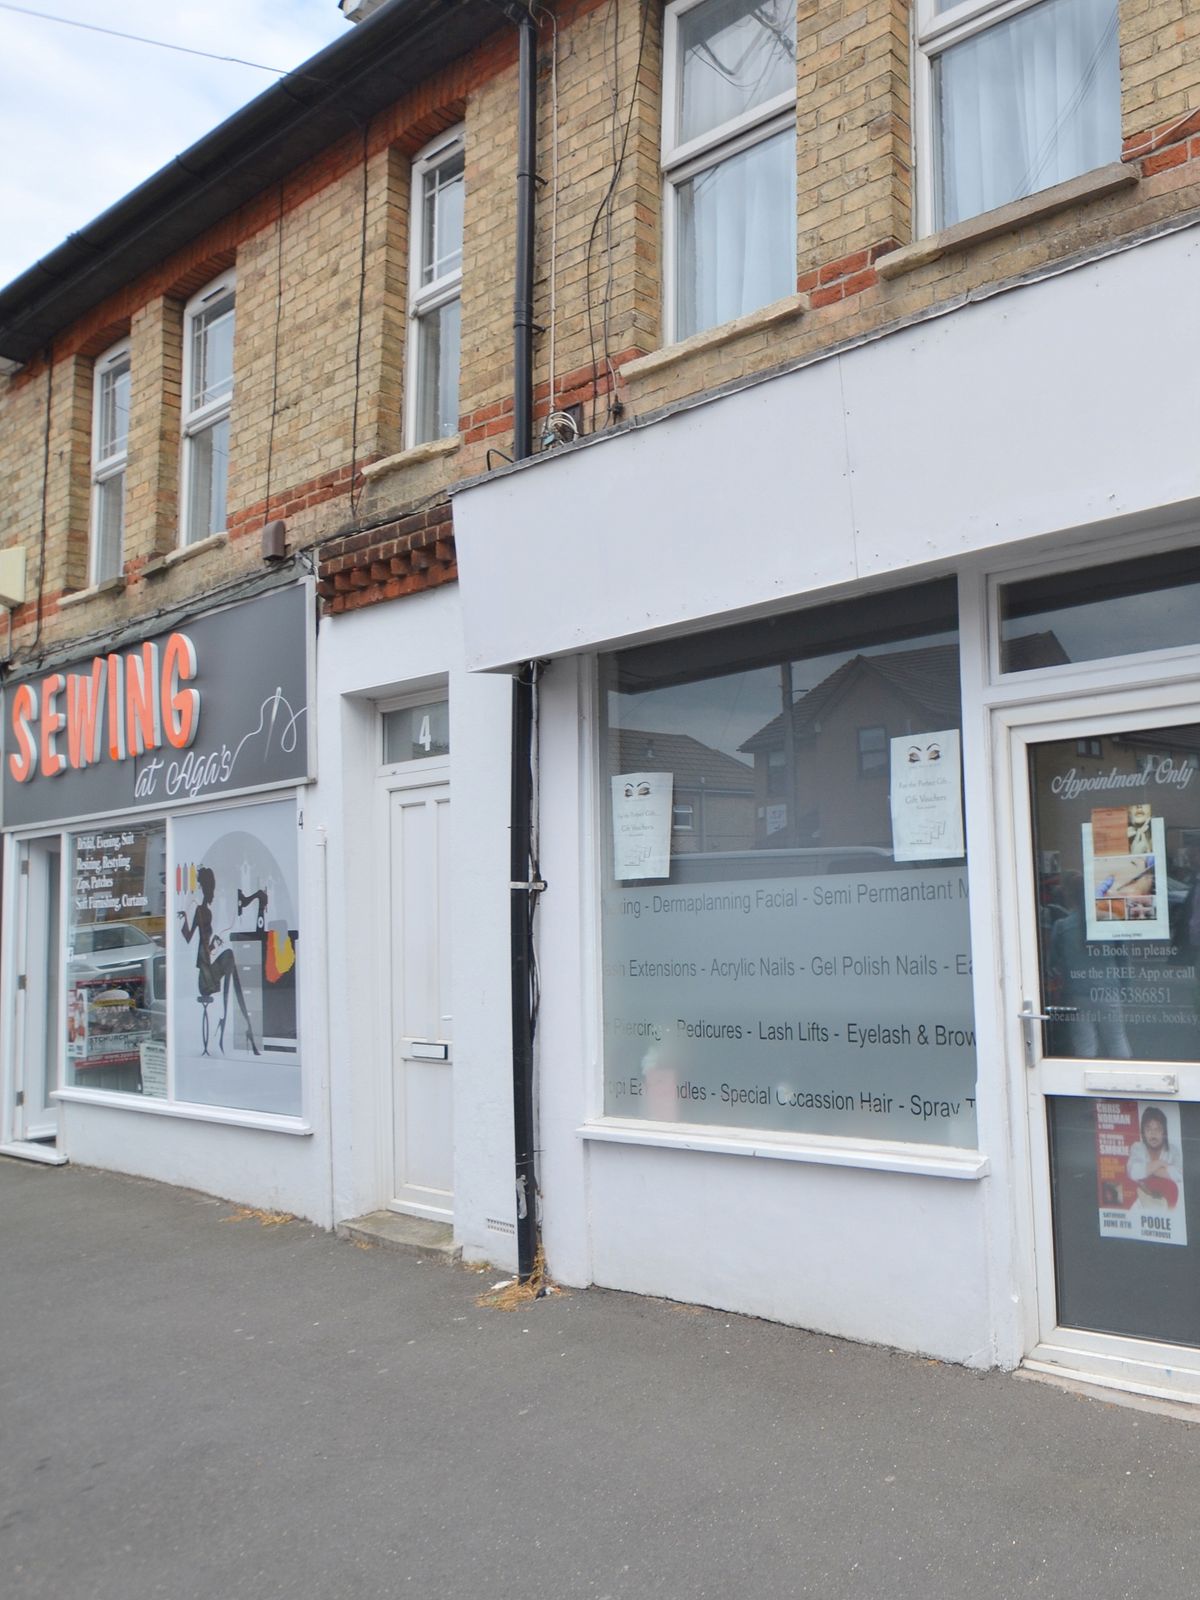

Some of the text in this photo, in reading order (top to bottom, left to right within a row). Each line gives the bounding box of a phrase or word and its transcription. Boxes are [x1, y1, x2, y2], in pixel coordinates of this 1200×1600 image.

[9, 633, 200, 783] SEWING
[419, 715, 432, 752] 4
[135, 744, 232, 799] at Aga's
[1051, 758, 1193, 800] Appointment Only
[653, 893, 751, 916] Dermaplanning
[756, 888, 798, 909] Facial
[813, 885, 851, 906] Semi
[857, 881, 953, 904] Permantant
[1086, 945, 1178, 959] To Book in please
[629, 959, 697, 977] Extensions
[711, 958, 756, 981] Acrylic
[760, 956, 795, 977] Nails
[811, 956, 837, 976] Gel
[842, 955, 890, 976] Polish
[896, 955, 938, 975] Nails
[956, 954, 973, 975] E
[1070, 970, 1086, 979] use
[1088, 968, 1103, 979] the
[1106, 967, 1135, 979] FREE
[1138, 968, 1161, 981] App
[1176, 966, 1195, 979] call
[677, 1019, 743, 1040] Pedicures
[759, 1021, 793, 1041] Lash
[798, 1021, 829, 1042] Lifts
[847, 1023, 911, 1048] Eyelash
[917, 1024, 929, 1045] &
[720, 1083, 771, 1107] Special
[860, 1091, 893, 1113] Hair
[1141, 1215, 1171, 1231] POOLE
